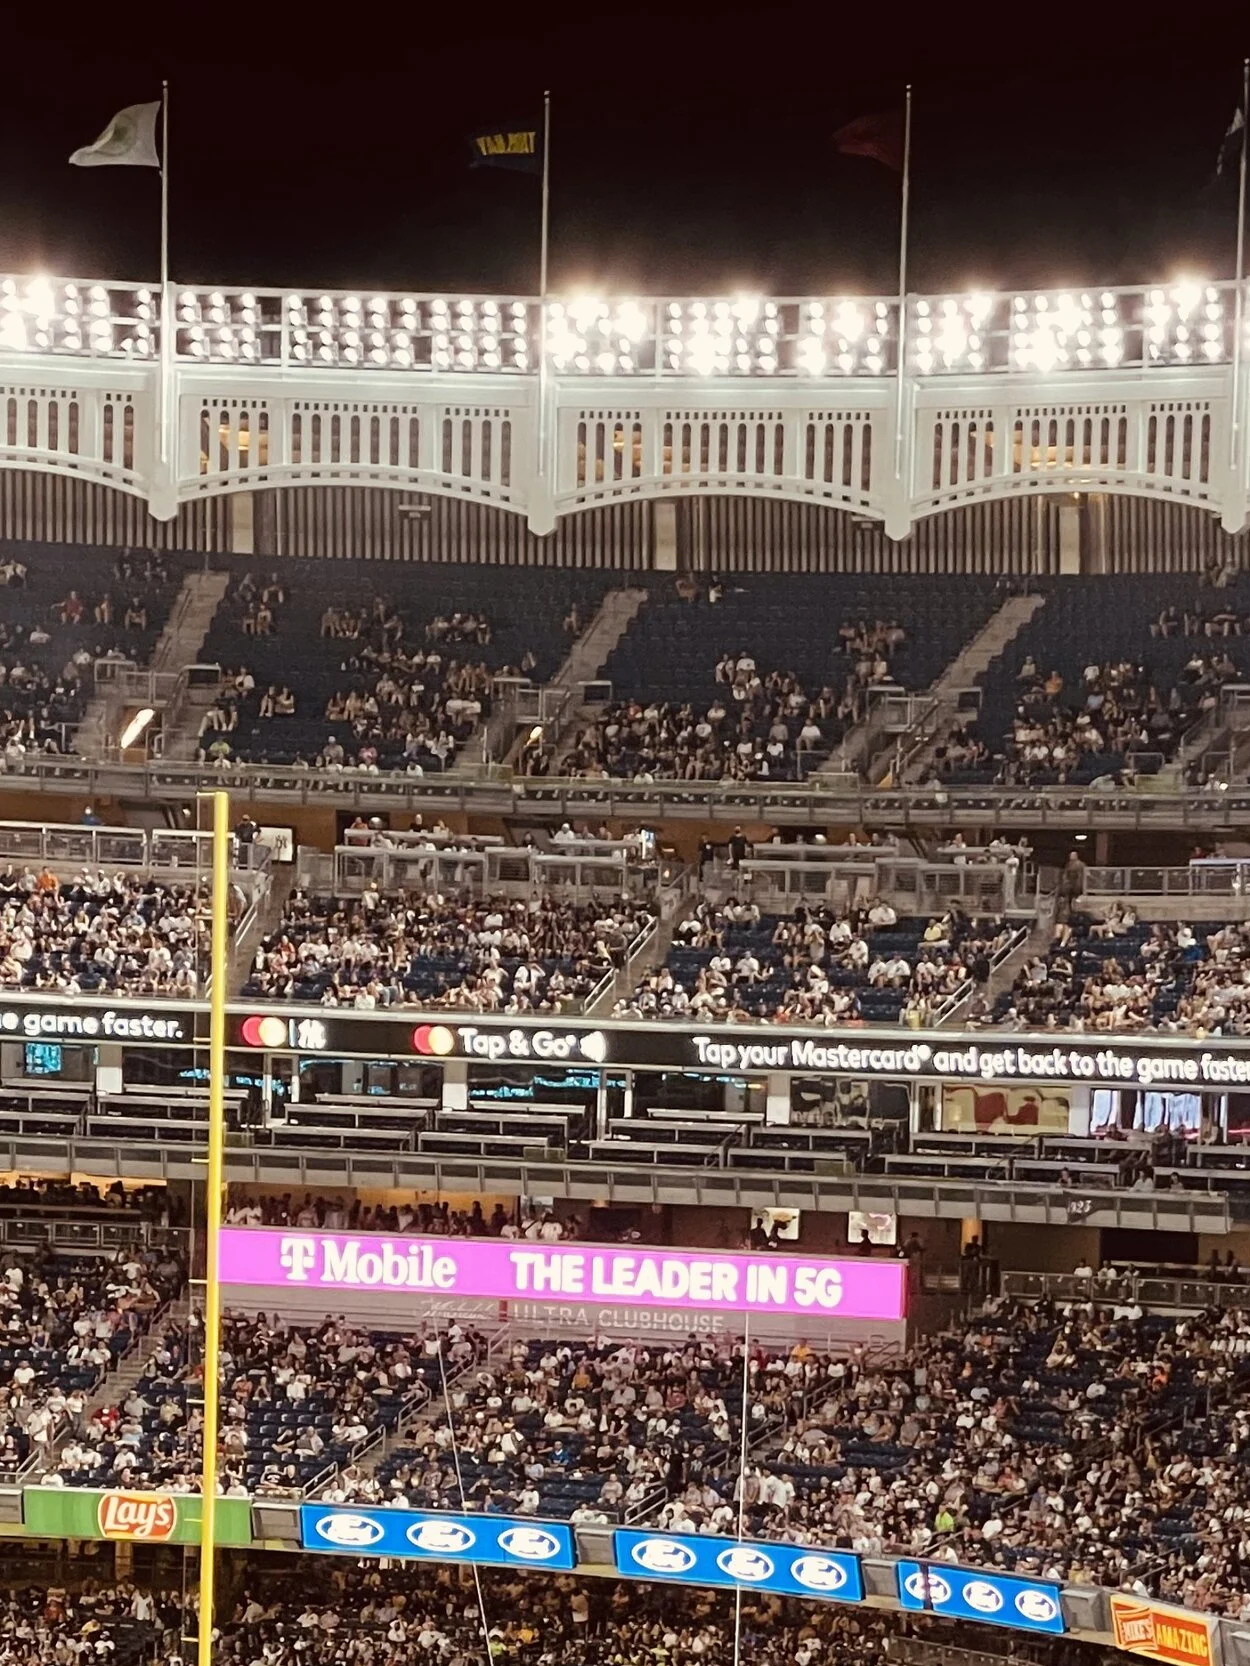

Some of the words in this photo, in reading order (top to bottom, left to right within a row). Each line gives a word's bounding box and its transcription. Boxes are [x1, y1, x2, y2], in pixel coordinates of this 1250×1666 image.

[23, 1014, 99, 1036] game
[101, 1011, 184, 1039] faster.
[458, 1027, 507, 1060] Tap
[509, 1029, 530, 1056] &
[692, 1036, 738, 1068] Tap
[738, 1043, 790, 1070] your
[934, 1046, 980, 1073] and
[979, 1050, 1016, 1079] get
[1017, 1048, 1068, 1076] back
[1068, 1052, 1098, 1078] to
[1097, 1050, 1133, 1079] the
[1137, 1056, 1199, 1084] game
[510, 1251, 584, 1294] THE
[592, 1256, 738, 1300] LEADER
[746, 1263, 787, 1305] IN
[794, 1267, 843, 1308] 5G
[514, 1303, 590, 1327] ULTRA
[599, 1308, 724, 1333] CLUBHOUSE
[104, 1495, 172, 1537] Lay's
[1156, 1623, 1208, 1658] AMAZING
